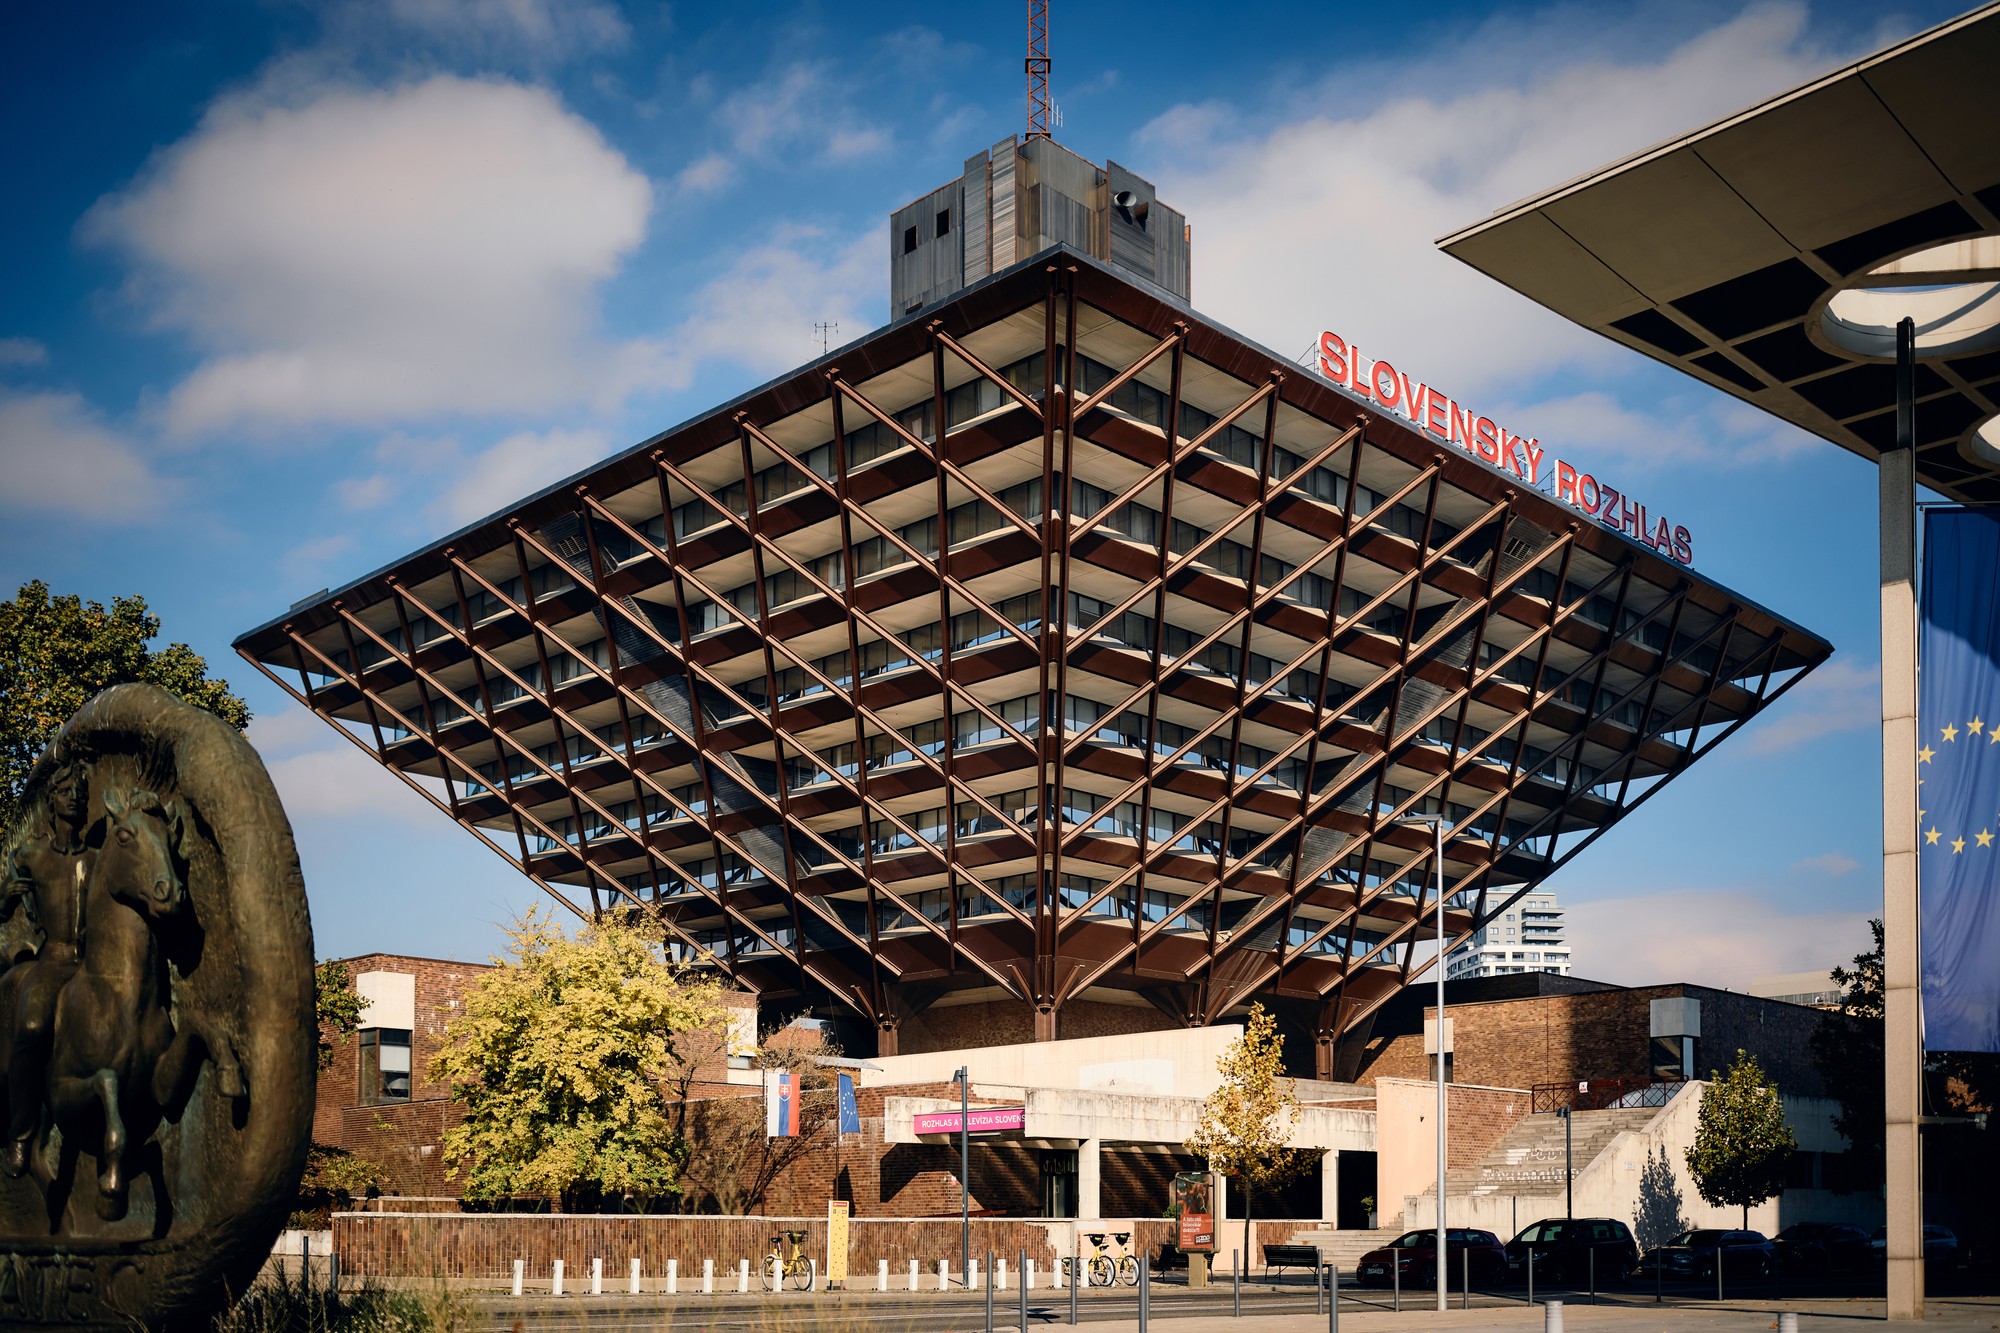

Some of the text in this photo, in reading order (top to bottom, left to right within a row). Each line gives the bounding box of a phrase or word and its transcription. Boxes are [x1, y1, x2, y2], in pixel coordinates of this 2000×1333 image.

[1317, 331, 1692, 565] SLOVENSKÝ ROZHLAS
[921, 1119, 953, 1128] ROZHLAS
[960, 1115, 993, 1126] TLEVÍZIA
